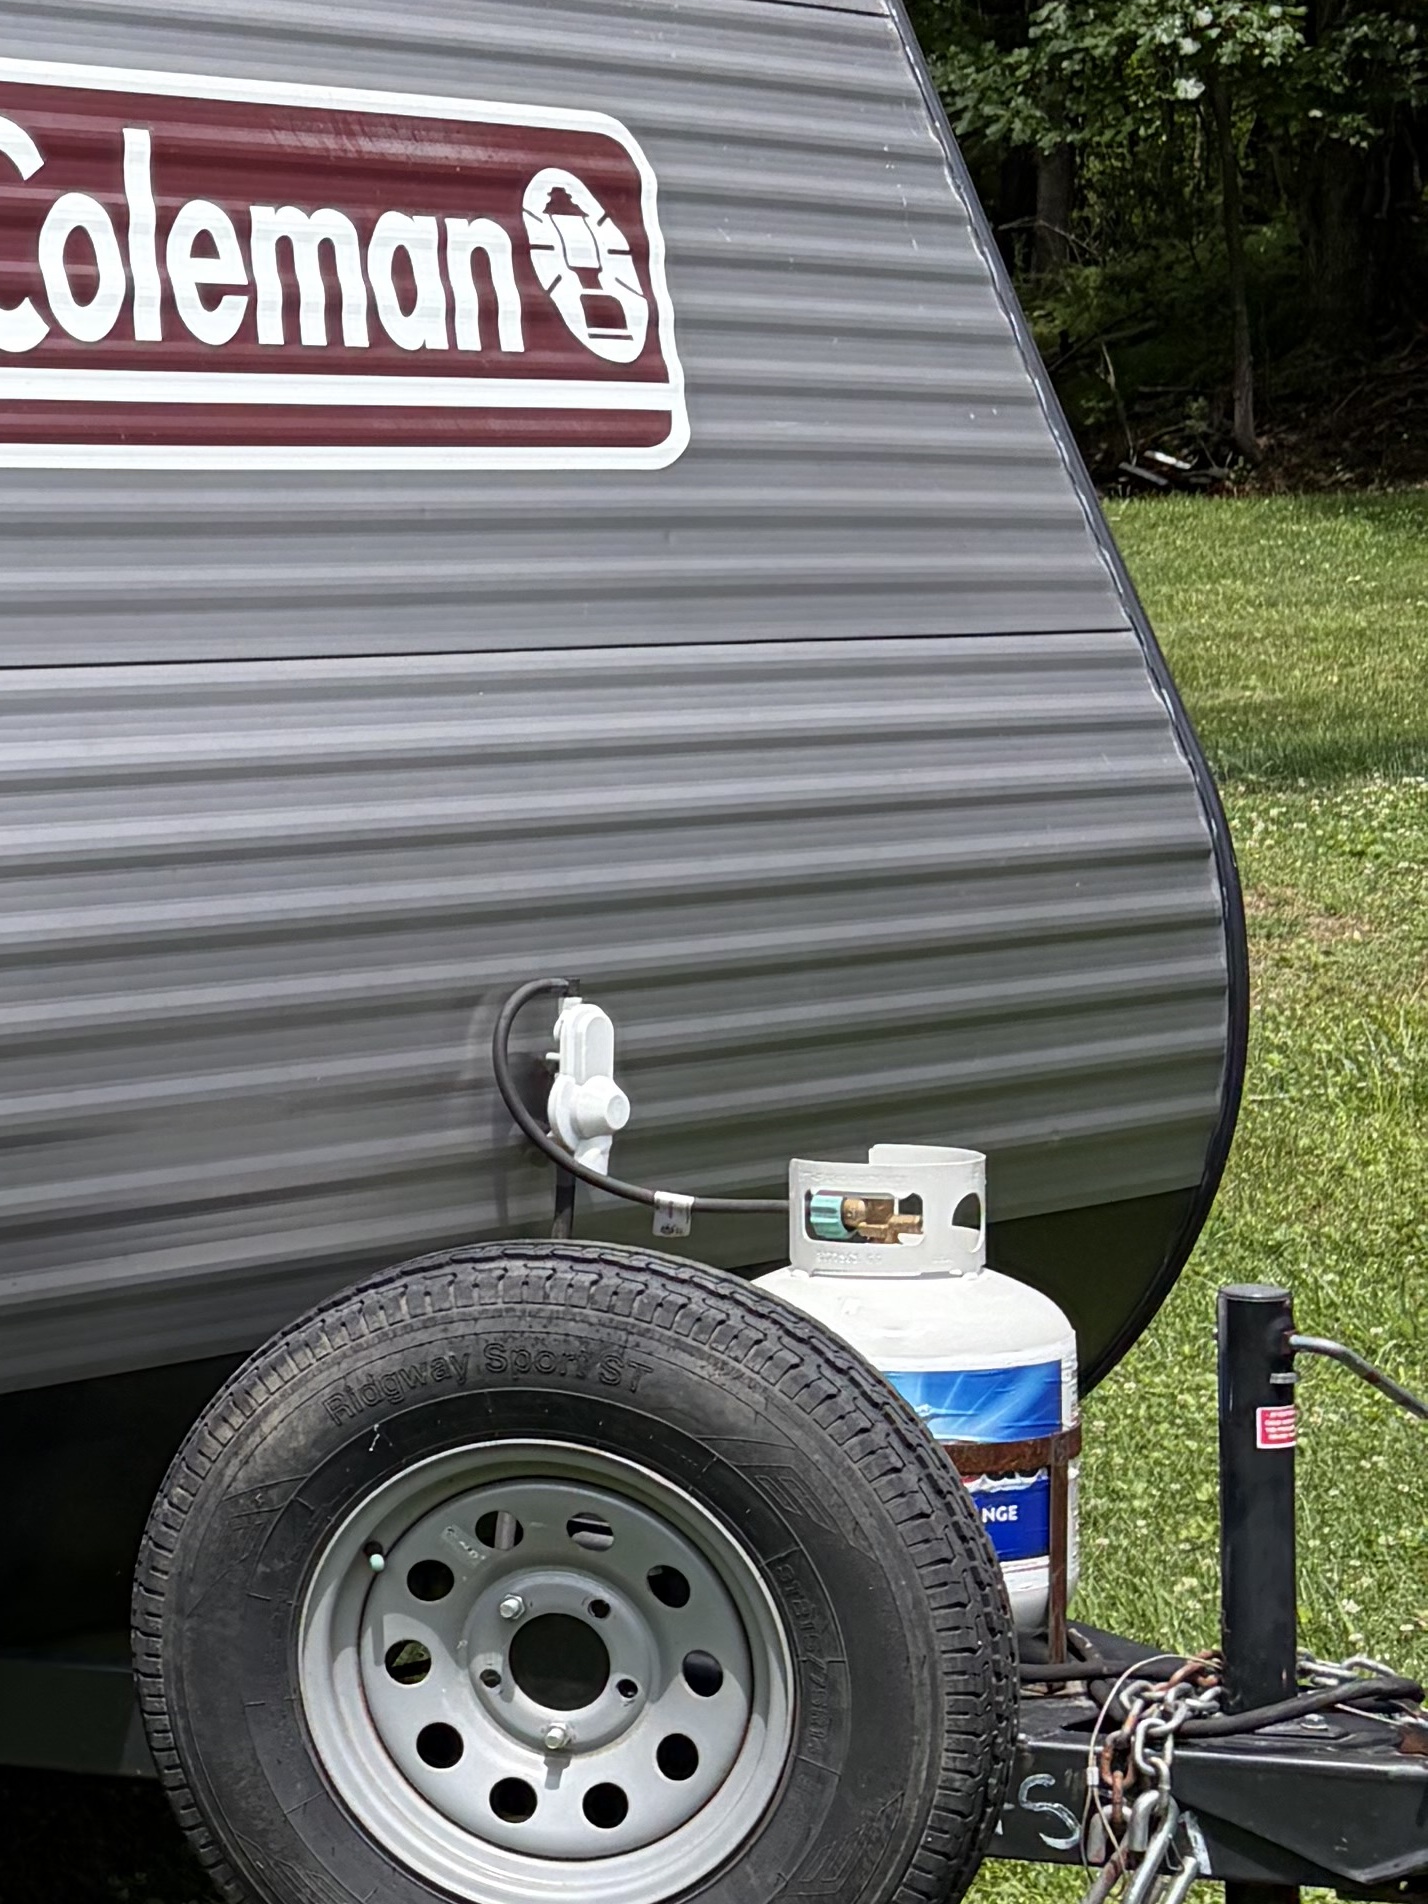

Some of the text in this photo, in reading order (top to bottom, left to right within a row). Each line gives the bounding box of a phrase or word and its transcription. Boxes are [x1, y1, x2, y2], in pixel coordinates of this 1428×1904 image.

[321, 1342, 654, 1426] Ridgway Sport ST
[981, 1504, 1019, 1523] NGE
[994, 1773, 1081, 1850] S
